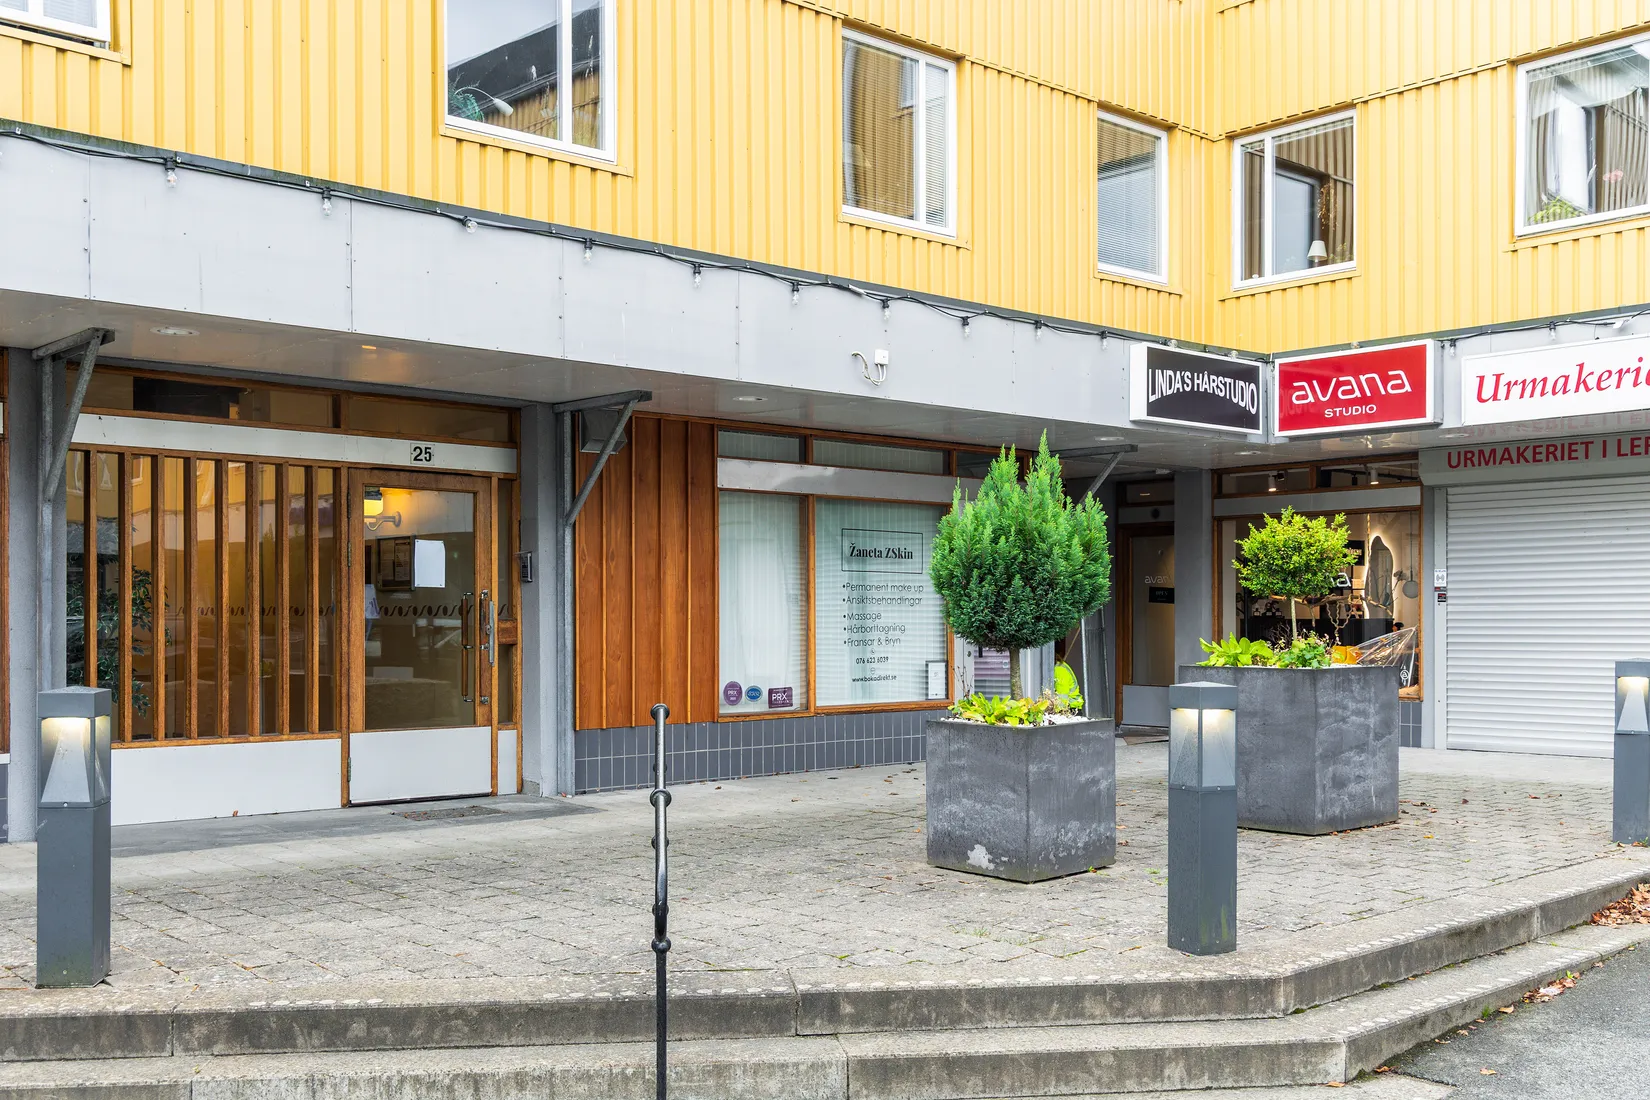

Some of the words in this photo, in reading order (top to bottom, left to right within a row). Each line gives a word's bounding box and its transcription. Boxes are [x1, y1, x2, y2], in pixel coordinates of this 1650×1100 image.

[1193, 370, 1258, 415] HÅRSTUDIO
[1291, 369, 1413, 405] avana
[1324, 404, 1377, 418] STUDIO
[413, 446, 432, 462] 25
[1447, 440, 1594, 469] URMAKERIET
[1602, 439, 1607, 459] I
[849, 542, 883, 559] Žaneta
[885, 547, 914, 560] ZSkin
[845, 582, 889, 592] Permanent
[890, 583, 912, 592] make
[913, 584, 924, 594] up
[845, 595, 923, 607] Ansiktsbehandlingar
[847, 612, 882, 622] Massage
[847, 623, 906, 634] Hårborttagning
[847, 637, 875, 647] Fransar
[877, 637, 882, 646] &
[884, 636, 901, 647] Bryn
[855, 657, 866, 665] 076
[876, 656, 889, 664] 6039
[771, 692, 788, 701] PRX
